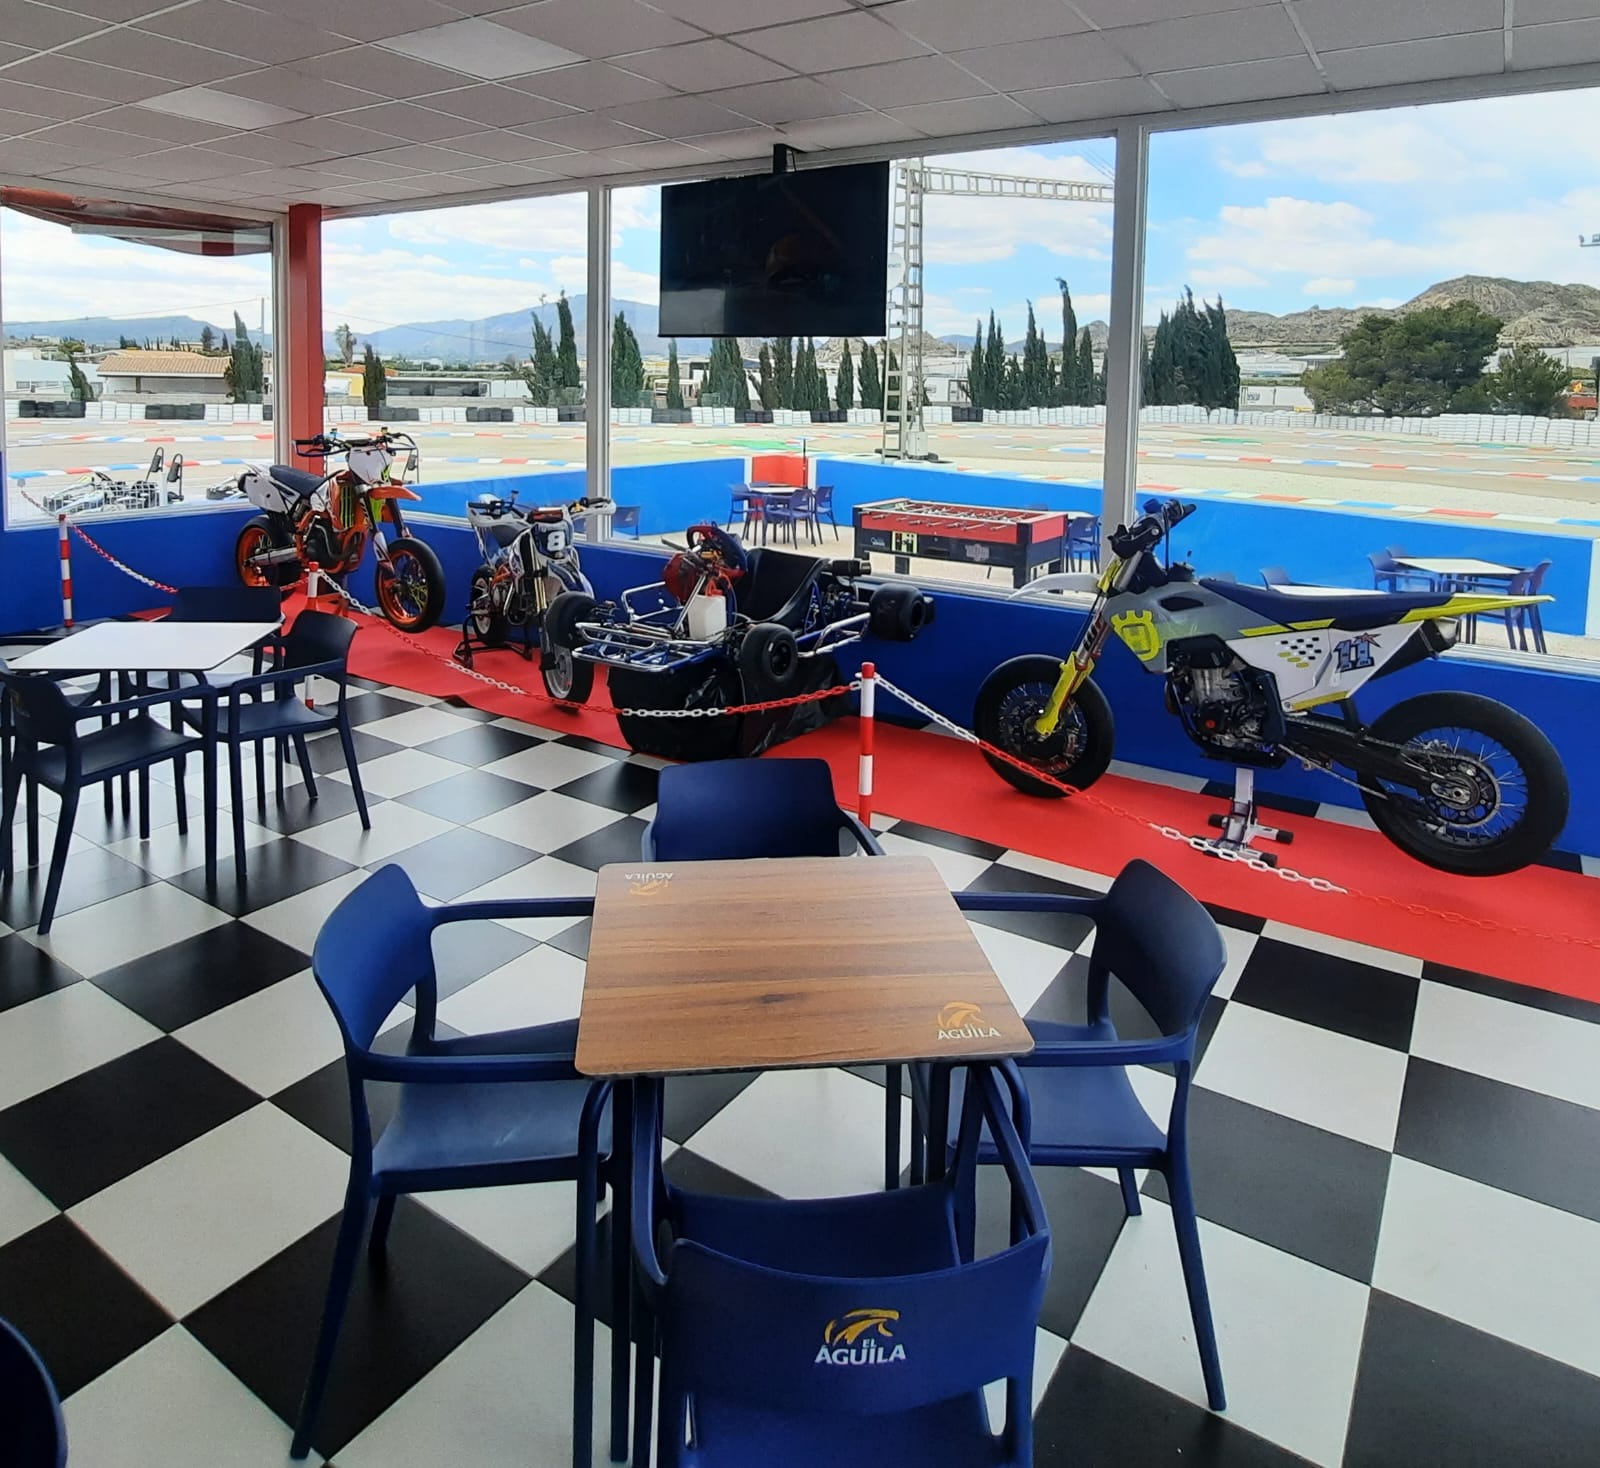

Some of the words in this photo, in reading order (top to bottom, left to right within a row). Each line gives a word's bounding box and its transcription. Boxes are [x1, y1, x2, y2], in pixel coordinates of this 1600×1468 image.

[547, 530, 565, 552] 8
[1333, 639, 1375, 673] 11
[862, 1338, 877, 1348] EL
